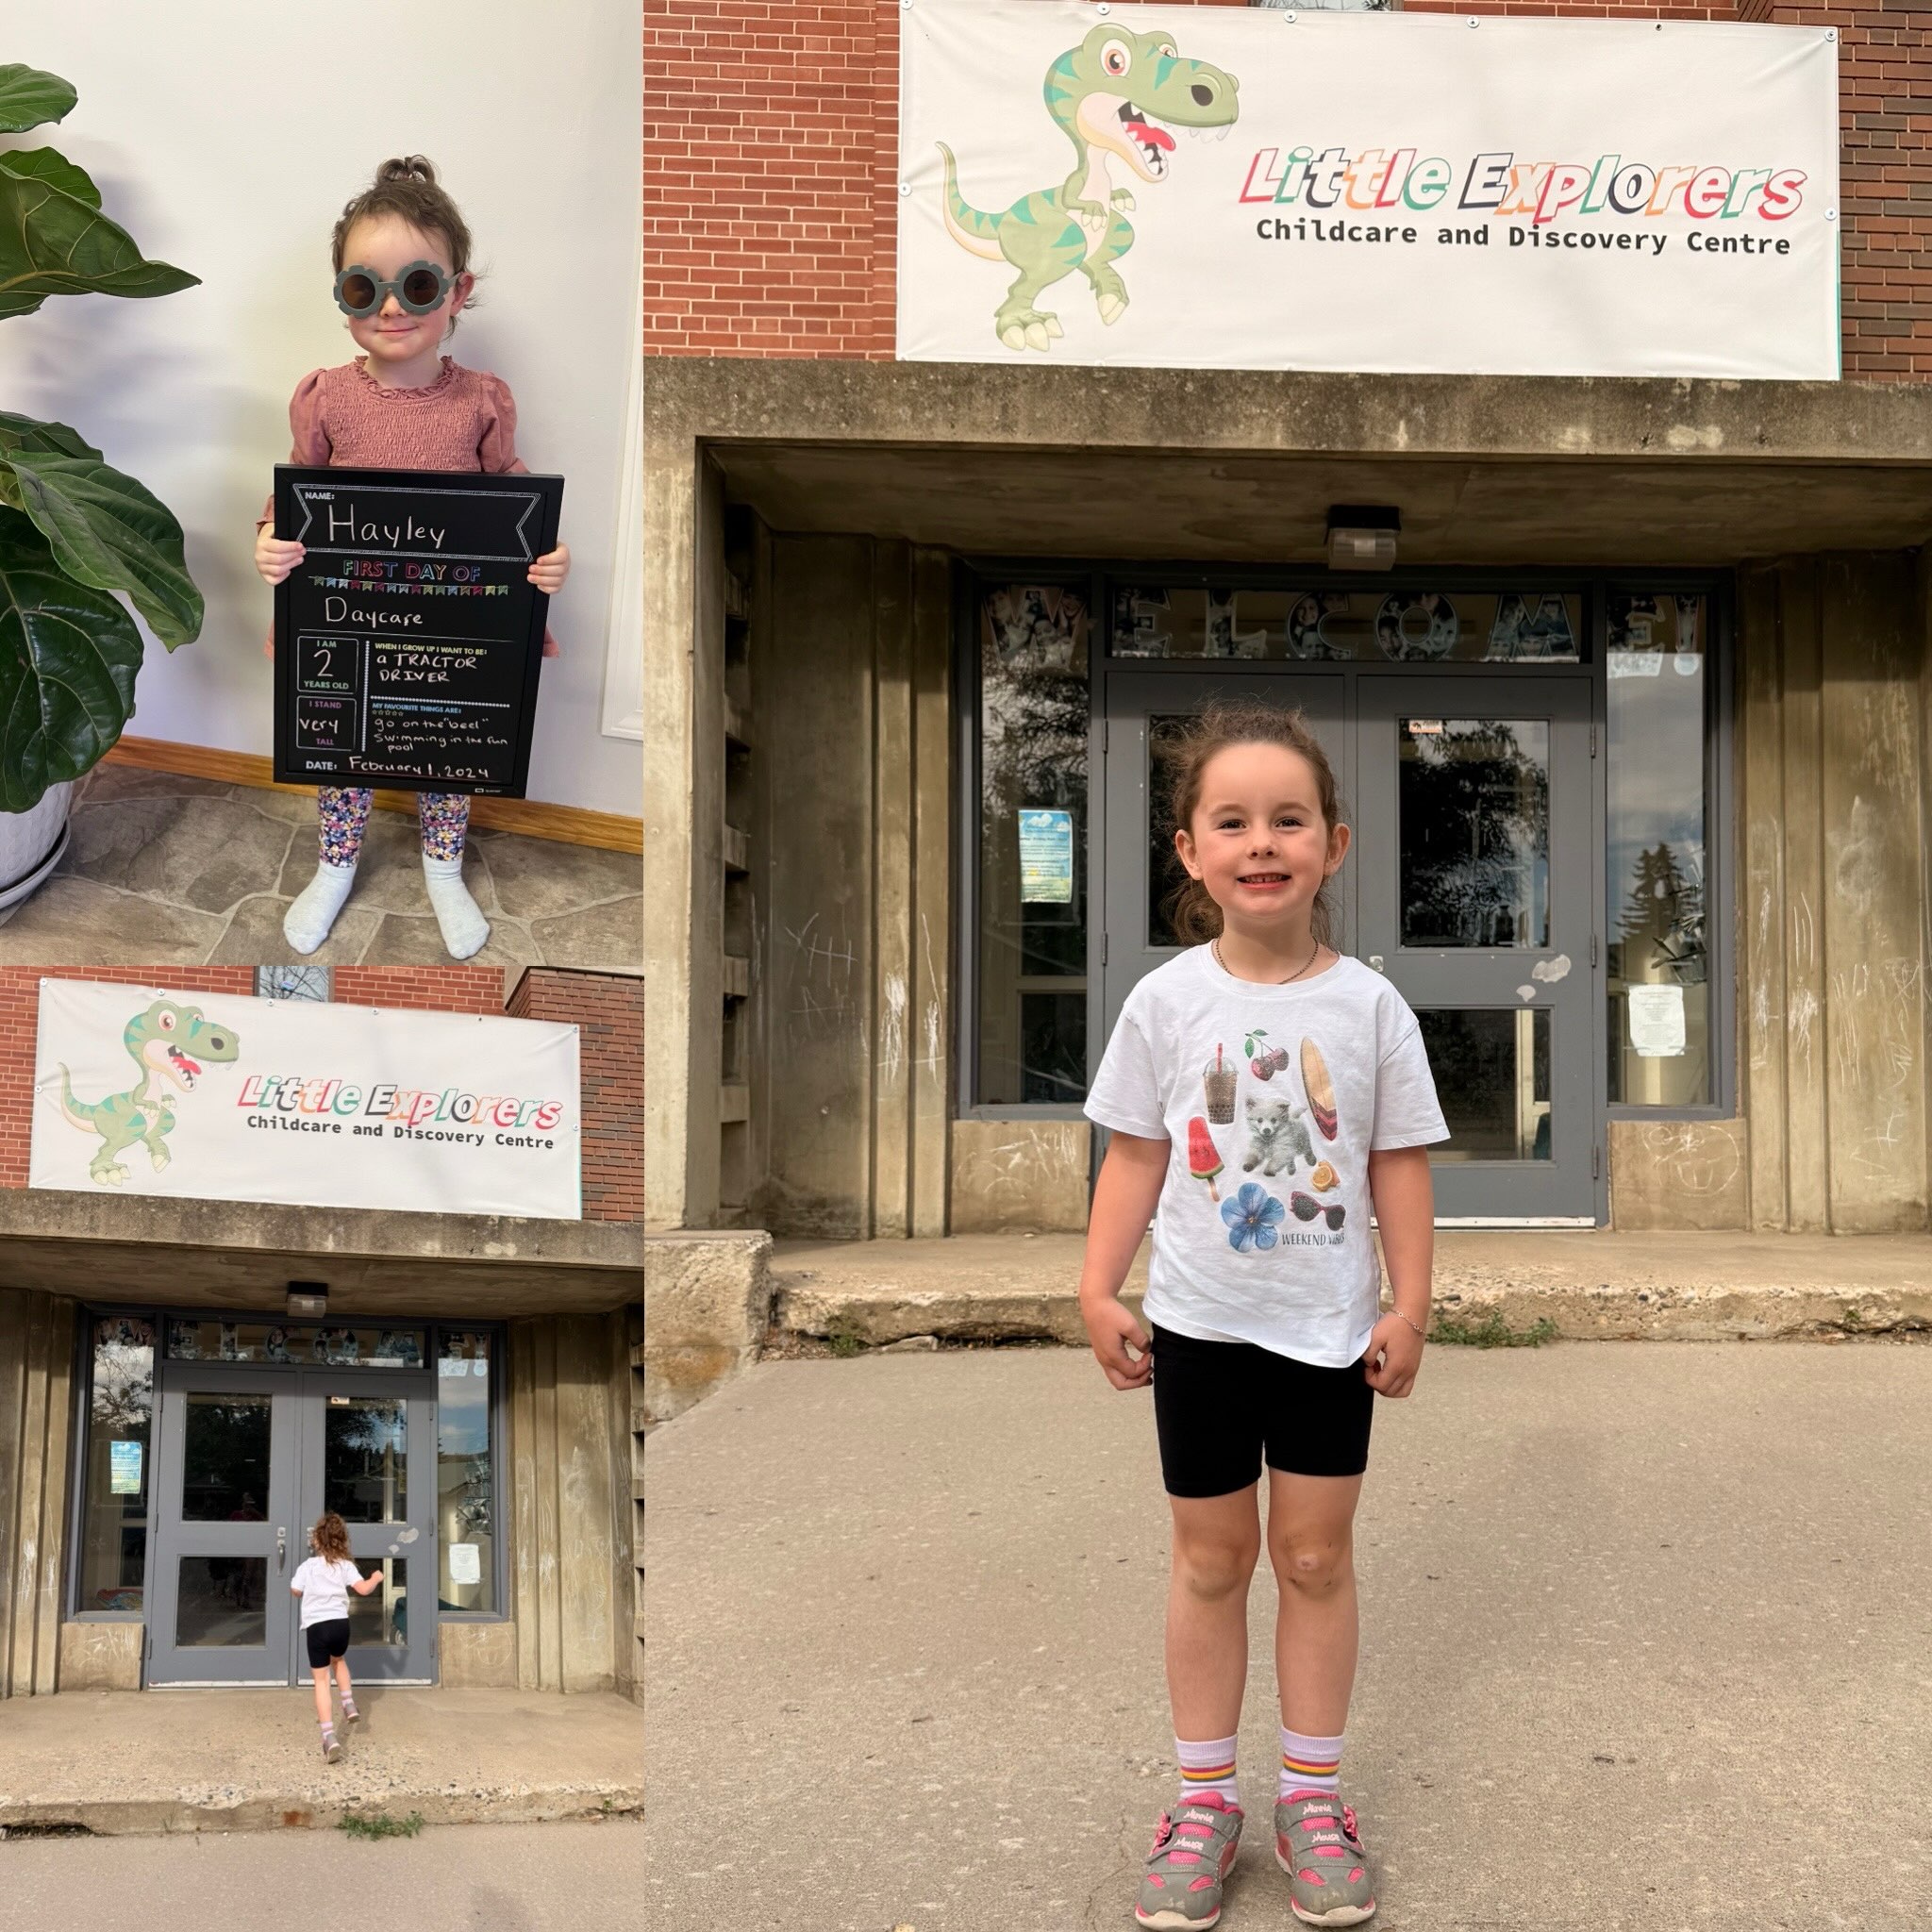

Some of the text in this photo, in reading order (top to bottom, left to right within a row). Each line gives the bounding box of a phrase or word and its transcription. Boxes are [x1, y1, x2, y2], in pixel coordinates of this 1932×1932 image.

[1240, 145, 1807, 225] Little Explorers
[1256, 218, 1791, 256] Childcare and Discovery Centre
[305, 491, 336, 501] NAME:
[327, 503, 446, 550] Hayley
[342, 559, 481, 582] FIRST DAY OF
[325, 595, 424, 629] Daycare
[322, 640, 338, 648] AM
[375, 642, 397, 651] WHEN
[402, 644, 425, 653] GROW
[441, 646, 462, 655] WANT
[464, 647, 475, 656] TO
[313, 649, 334, 677] 2
[376, 653, 478, 671] a TRACTOR
[379, 668, 451, 684] DRIVER
[304, 679, 350, 691] YEARS OLD
[314, 700, 342, 709] STAND
[383, 704, 419, 712] FAVOURITE
[299, 717, 339, 735] very
[374, 717, 395, 733] go
[402, 720, 420, 728] on
[422, 719, 444, 729] the
[316, 738, 334, 746] TALL
[387, 741, 414, 753] pool
[465, 735, 483, 744] the
[487, 736, 508, 745] fun
[305, 760, 338, 771] DATE:
[348, 756, 422, 775] February
[443, 765, 489, 779] 2024
[237, 1074, 564, 1130] Little Explorers
[246, 1114, 555, 1150] Childcare and Discovery Centre
[1282, 1233, 1325, 1245] WEEKEND
[1183, 1808, 1215, 1824] Minnie
[1302, 1802, 1333, 1815] Minnie
[1174, 1837, 1204, 1851] Mouse
[1311, 1831, 1341, 1843] Mouse
